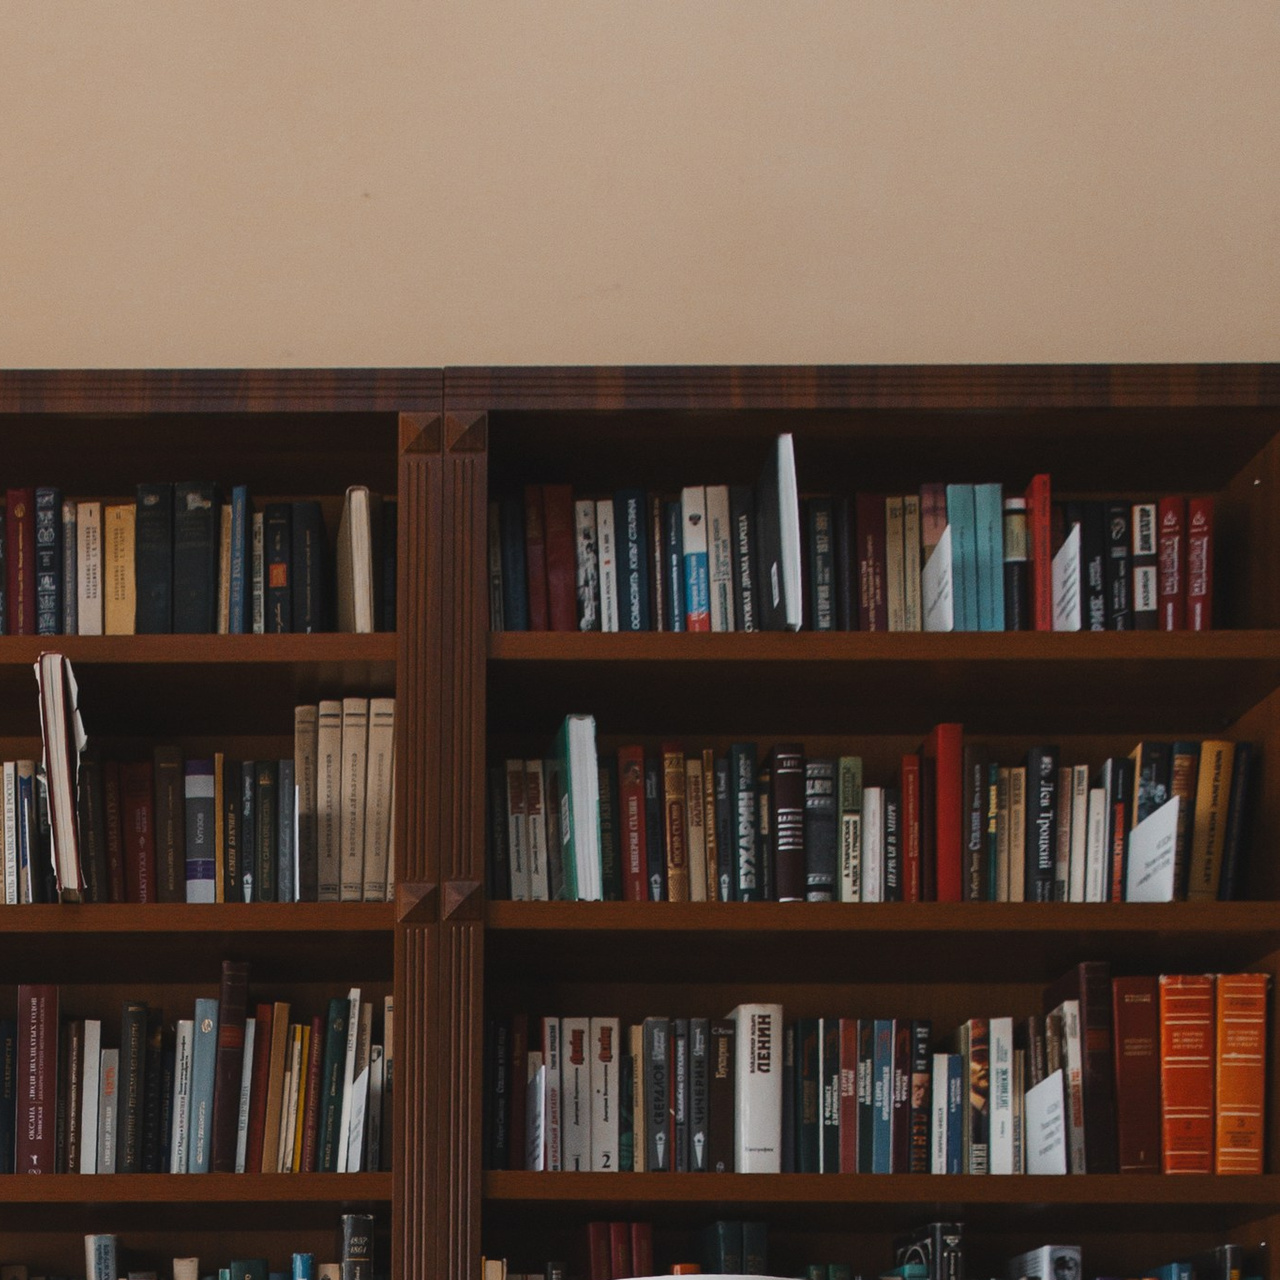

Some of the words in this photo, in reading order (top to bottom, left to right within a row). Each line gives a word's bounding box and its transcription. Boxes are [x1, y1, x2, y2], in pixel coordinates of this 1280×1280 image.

[1038, 780, 1054, 807] Лев
[738, 791, 756, 891] БУХАРИН
[1037, 809, 1054, 869] Троцкий
[757, 1014, 772, 1075] ЛЕНИН
[28, 1106, 36, 1141] ОКСАНА
[653, 1065, 666, 1126] СВЕРДЛОВ
[694, 1060, 705, 1126] ЧИЧЕРИН
